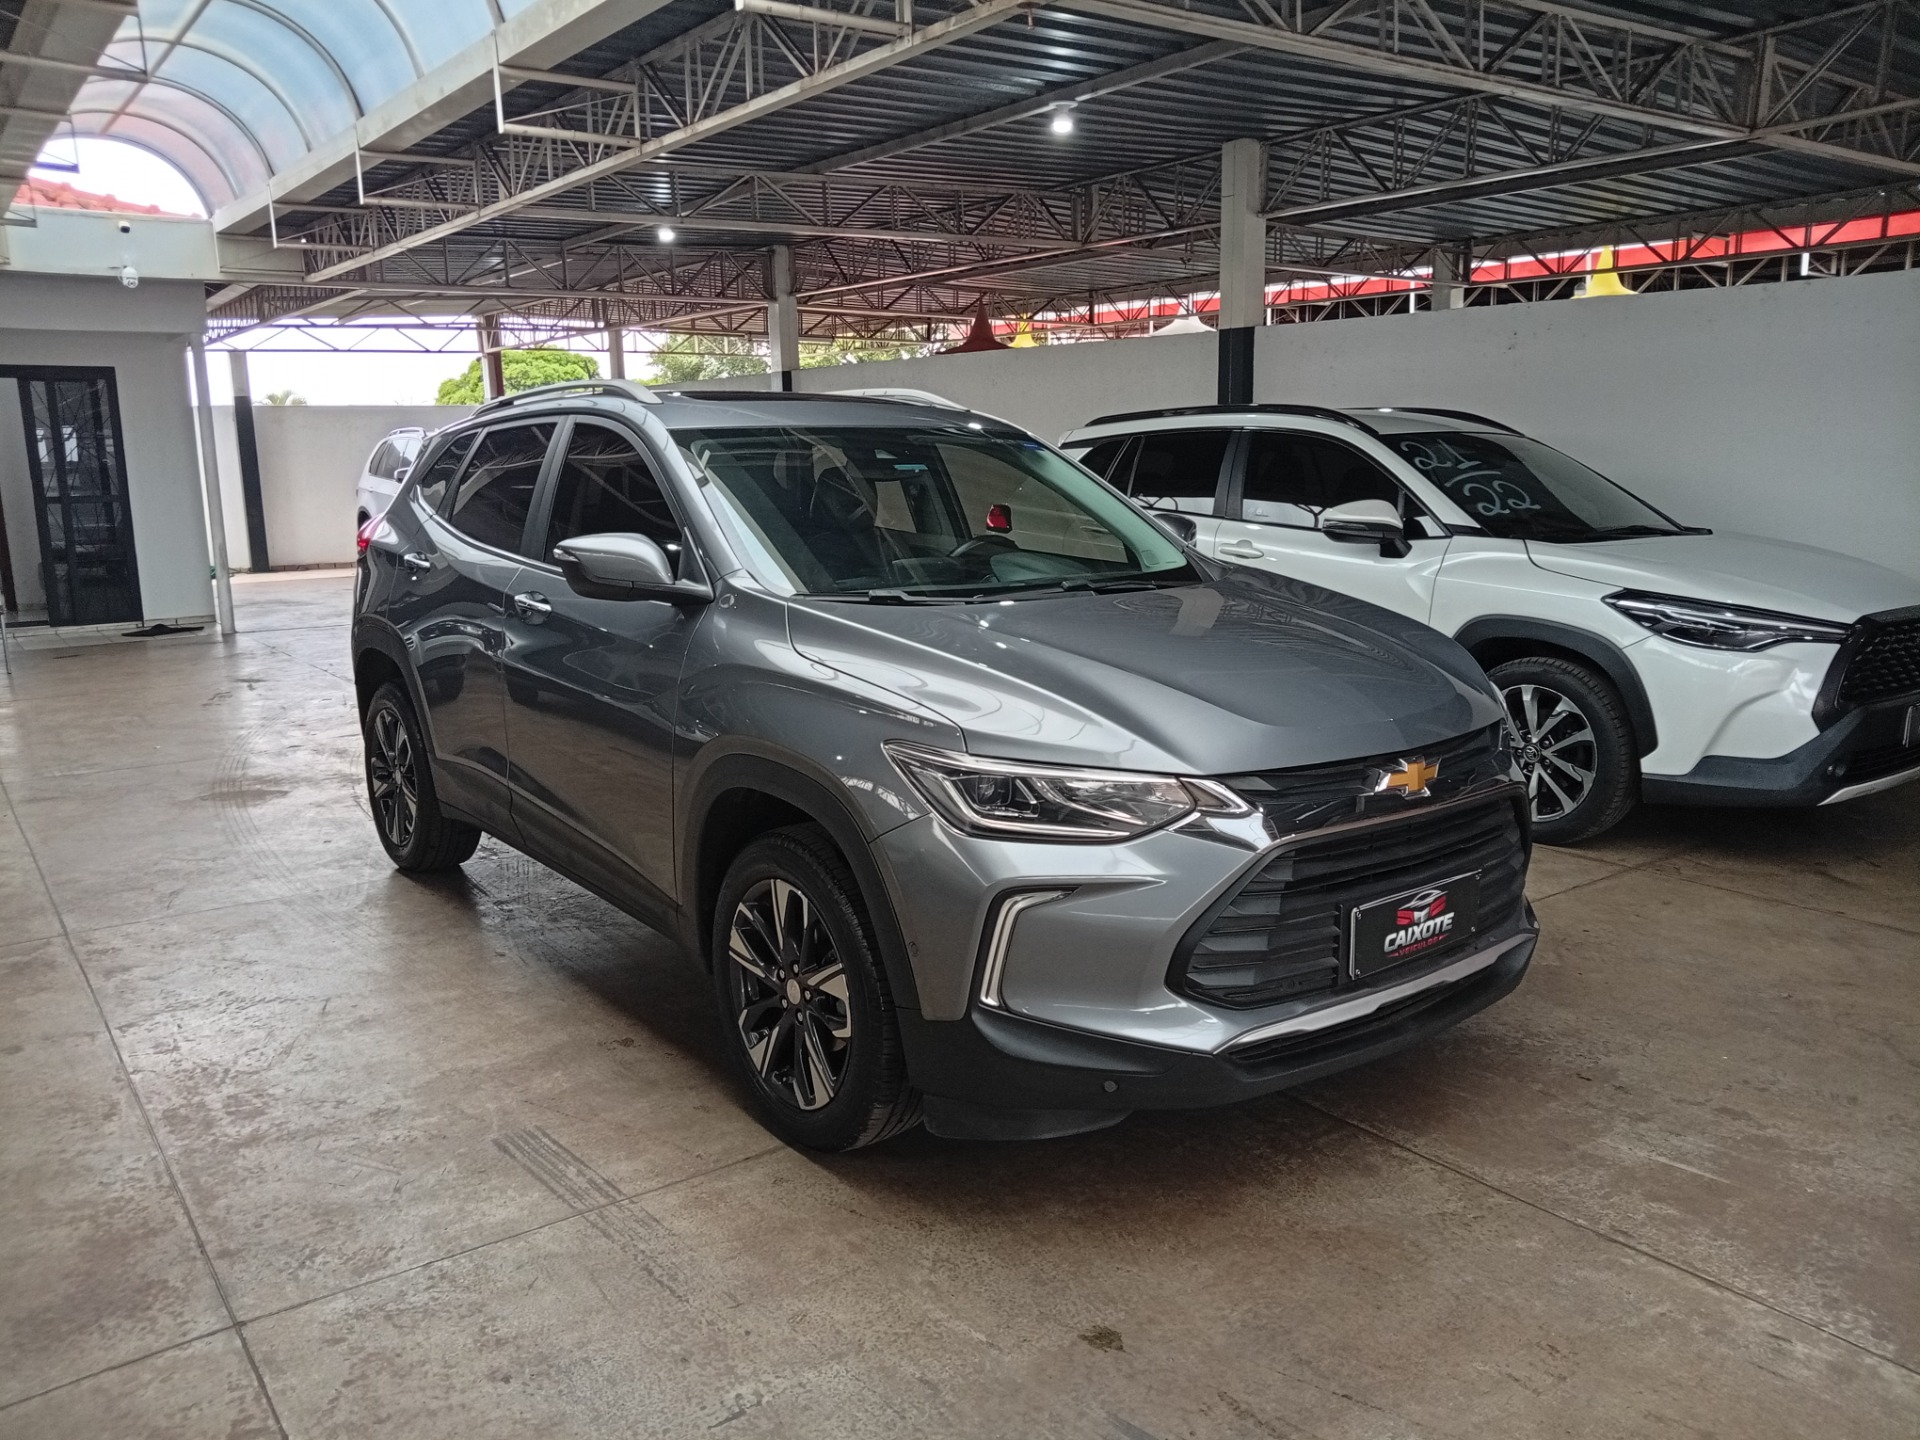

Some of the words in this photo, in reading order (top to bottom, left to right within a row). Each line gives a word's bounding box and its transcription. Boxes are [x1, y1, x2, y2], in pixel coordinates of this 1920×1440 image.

[1400, 439, 1482, 470] 21
[1462, 480, 1541, 516] 22
[1384, 912, 1455, 952] CAIXOTE
